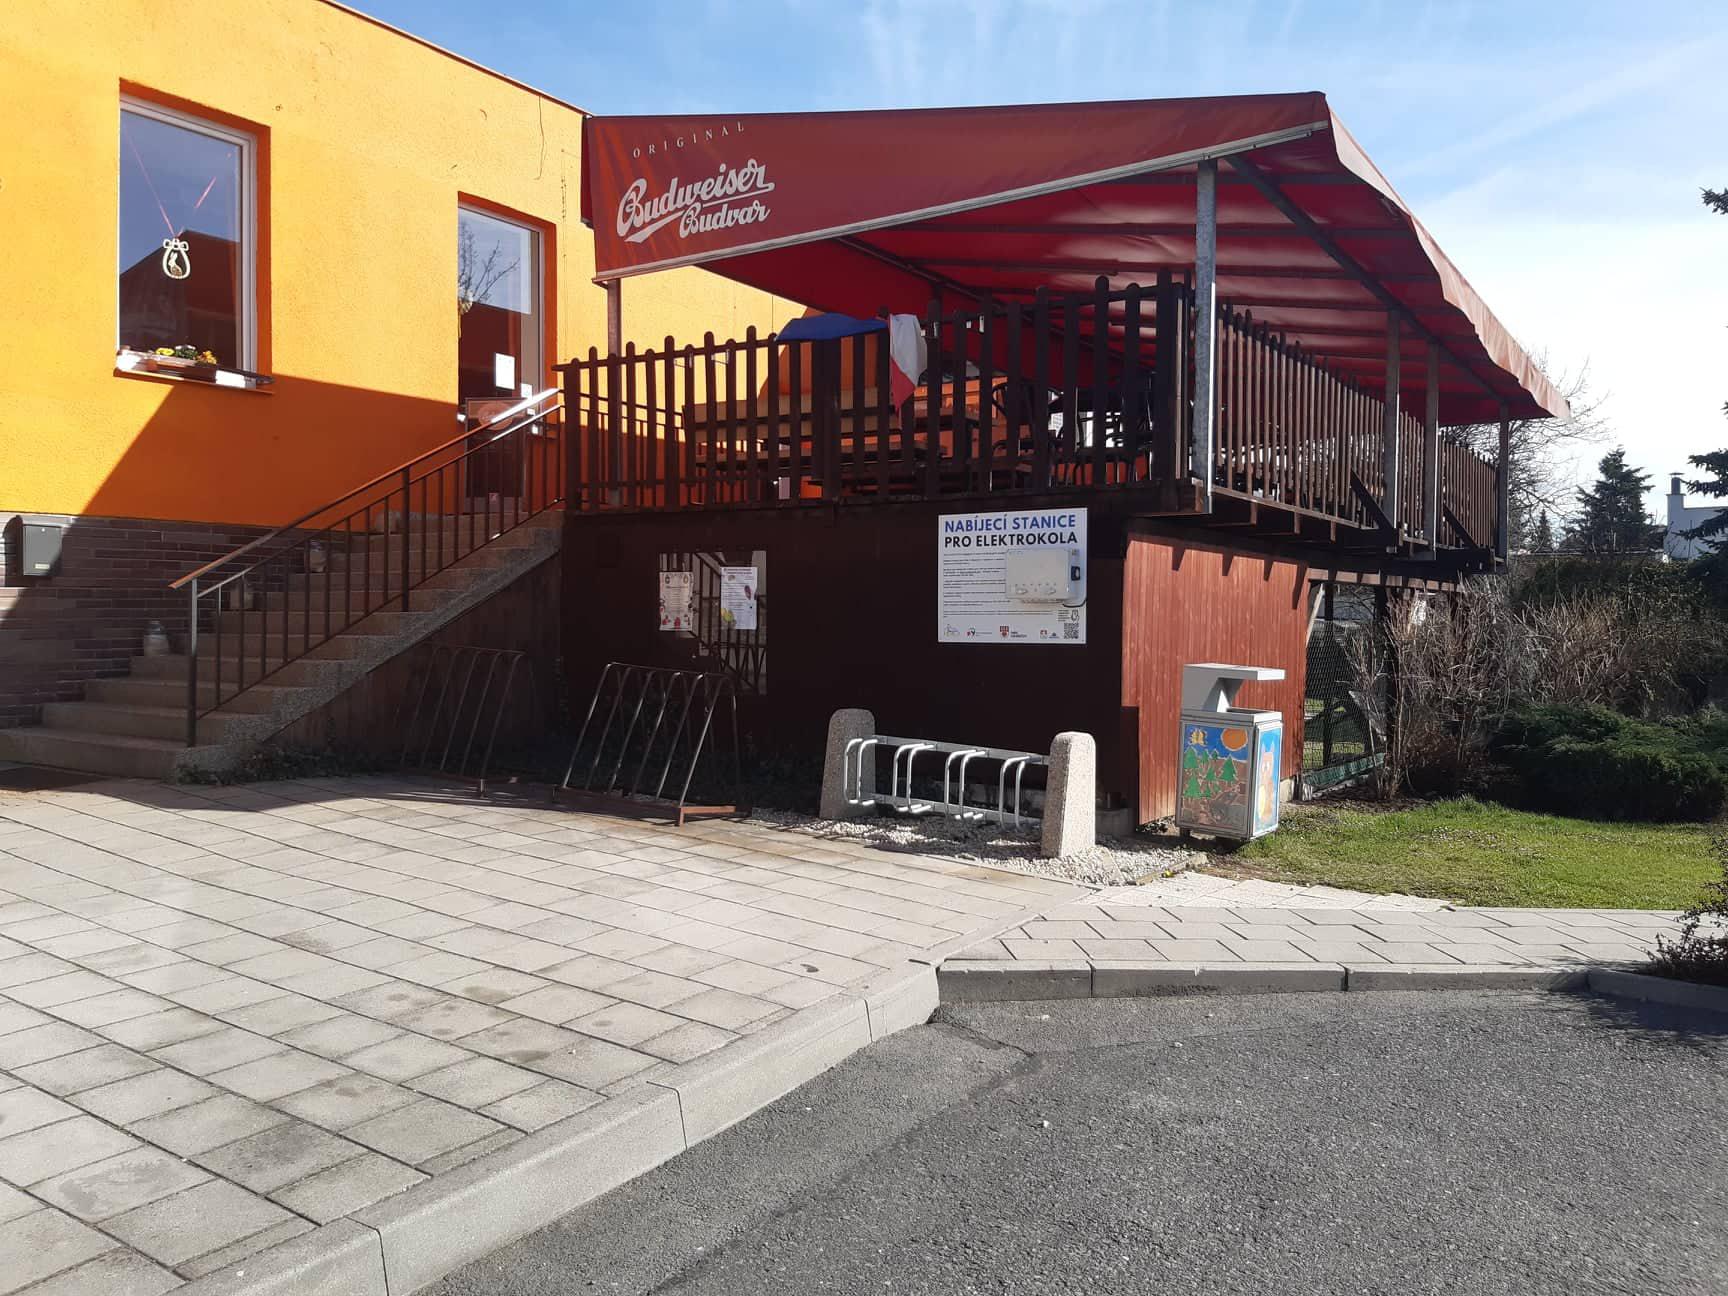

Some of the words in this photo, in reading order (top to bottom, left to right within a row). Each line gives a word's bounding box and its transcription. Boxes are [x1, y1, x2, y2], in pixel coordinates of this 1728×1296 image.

[633, 121, 744, 158] ORIGINAL
[616, 158, 776, 240] Budweiser
[679, 200, 771, 239] Budvar
[944, 514, 1008, 533] NABÍJECÍ
[1012, 514, 1076, 530] STANICE
[944, 535, 972, 548] PRO
[976, 531, 1078, 548] ELEKTROKOLA
